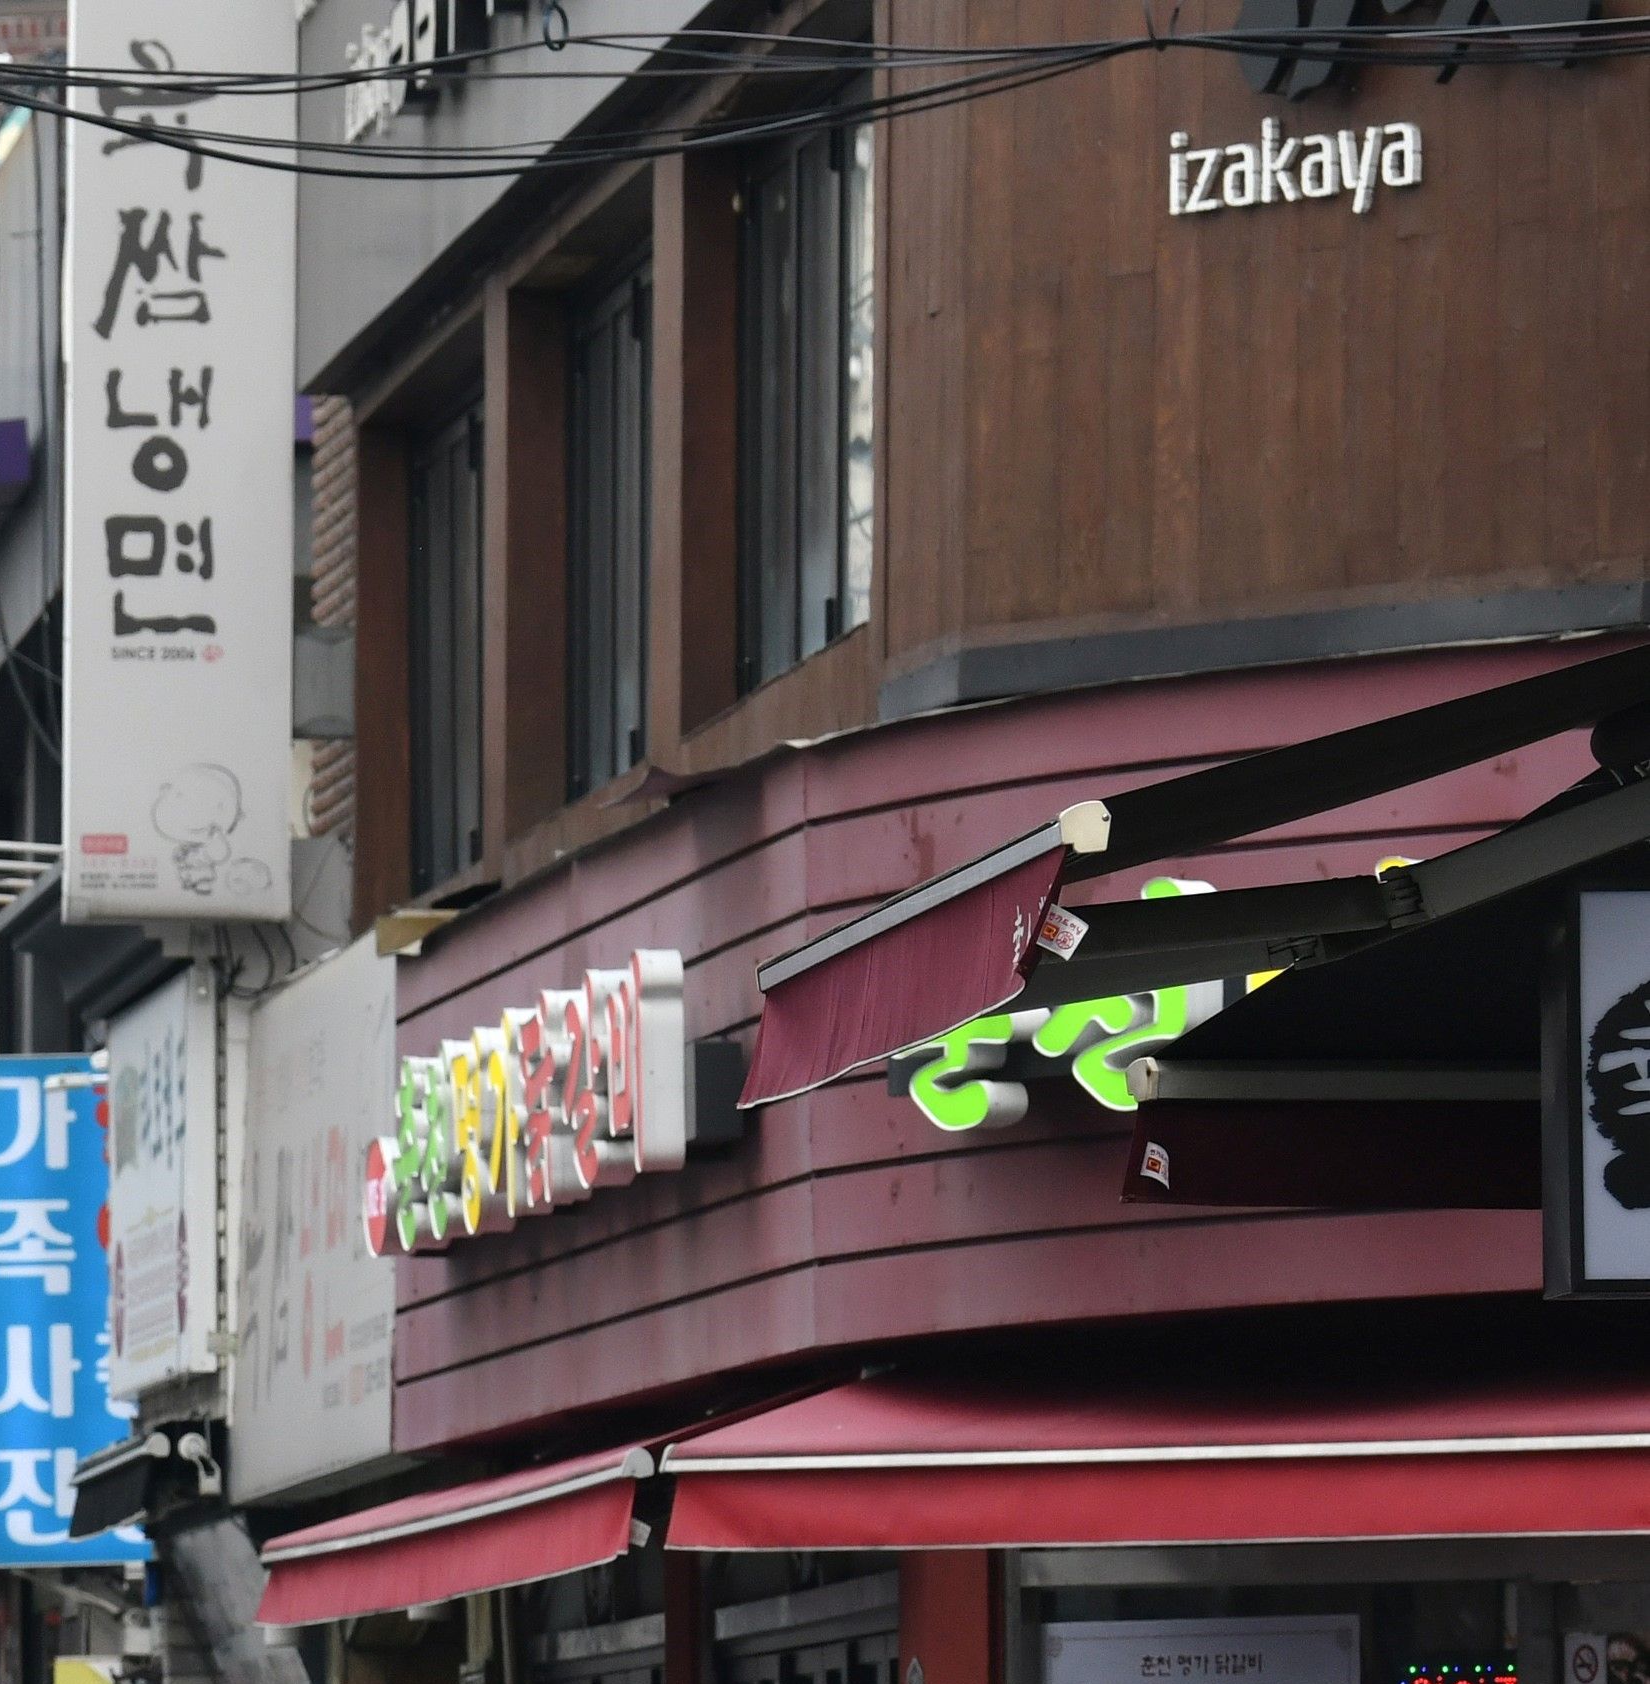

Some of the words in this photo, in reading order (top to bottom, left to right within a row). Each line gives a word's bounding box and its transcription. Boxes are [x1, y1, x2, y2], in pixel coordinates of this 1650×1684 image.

[1168, 116, 1422, 216] izakaya
[1142, 1655, 1171, 1677] 춘천
[1178, 1654, 1209, 1676] 명가
